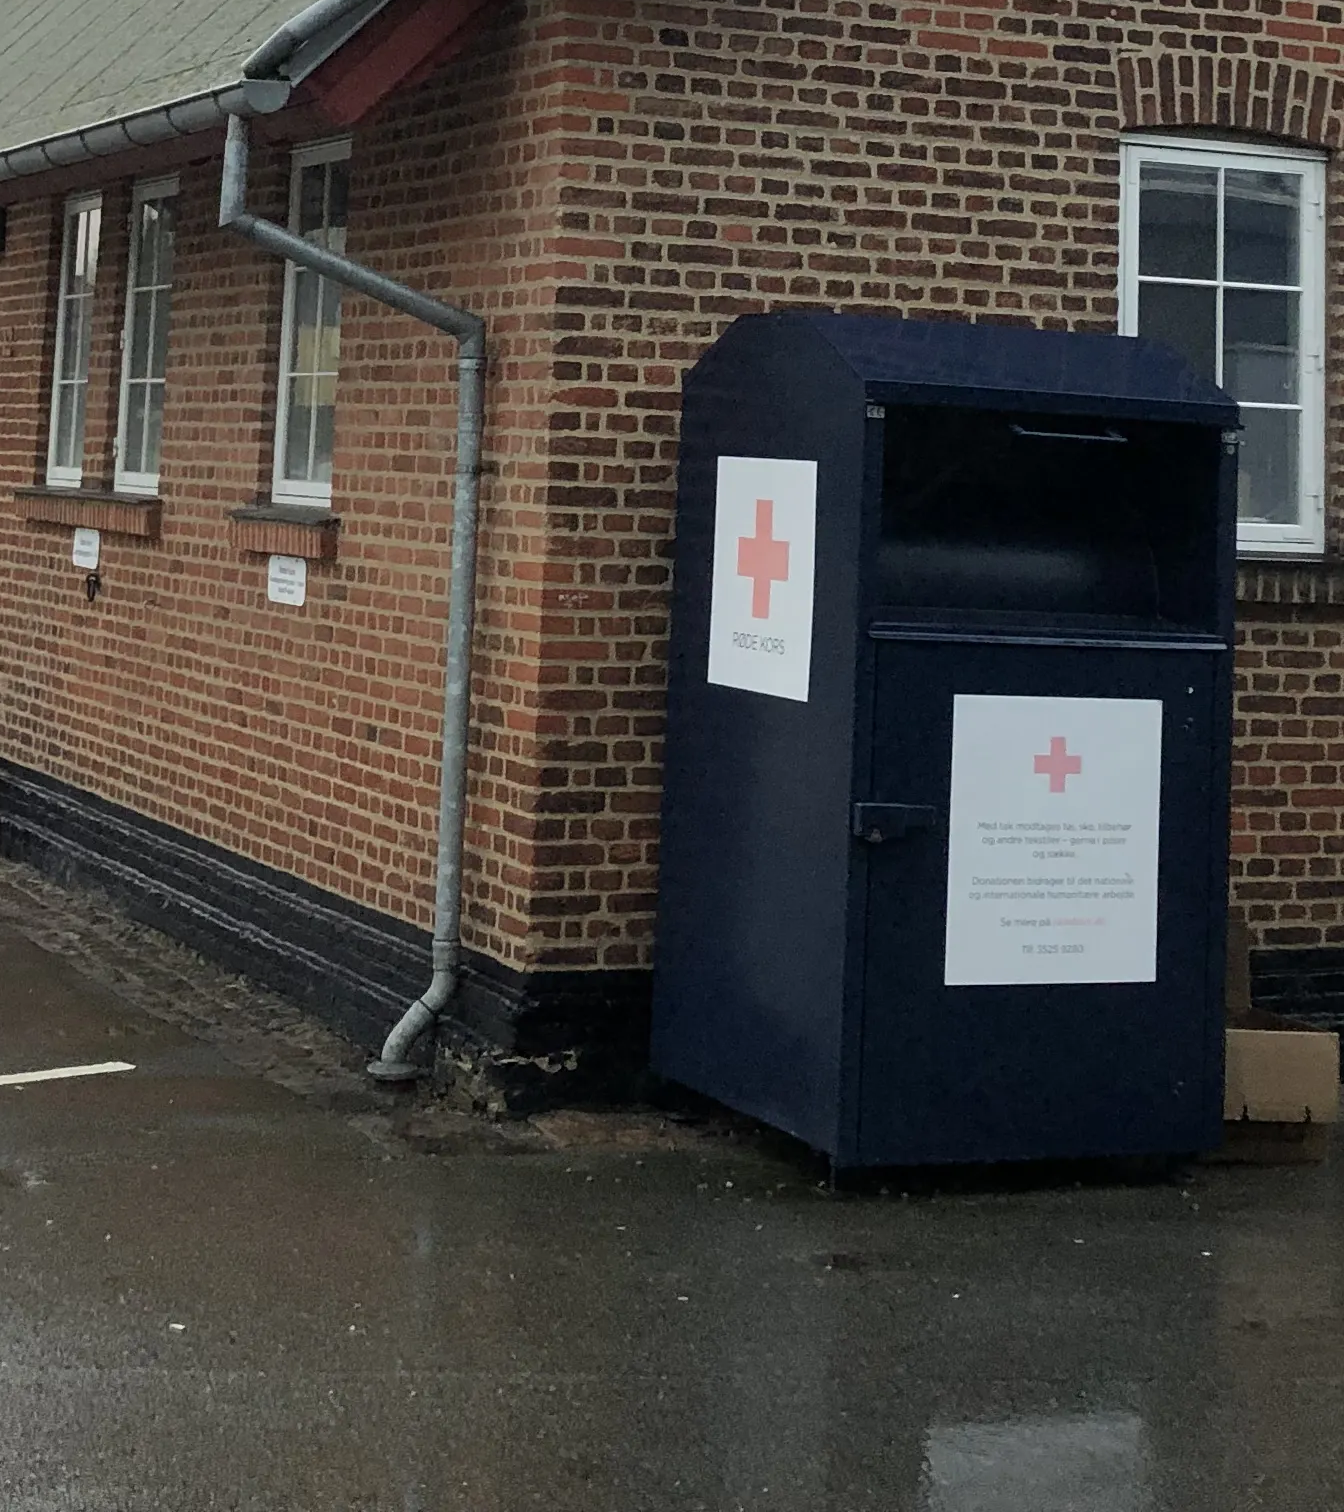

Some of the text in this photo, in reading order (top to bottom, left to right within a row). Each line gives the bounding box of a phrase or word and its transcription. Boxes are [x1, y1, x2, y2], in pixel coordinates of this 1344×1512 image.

[732, 631, 786, 655] RØDE KORS
[977, 821, 997, 831] Med
[981, 837, 995, 846] og
[1032, 850, 1046, 859] og
[1077, 876, 1092, 886] det
[968, 892, 982, 901] og
[1000, 916, 1012, 927] Se
[1038, 917, 1051, 929] på
